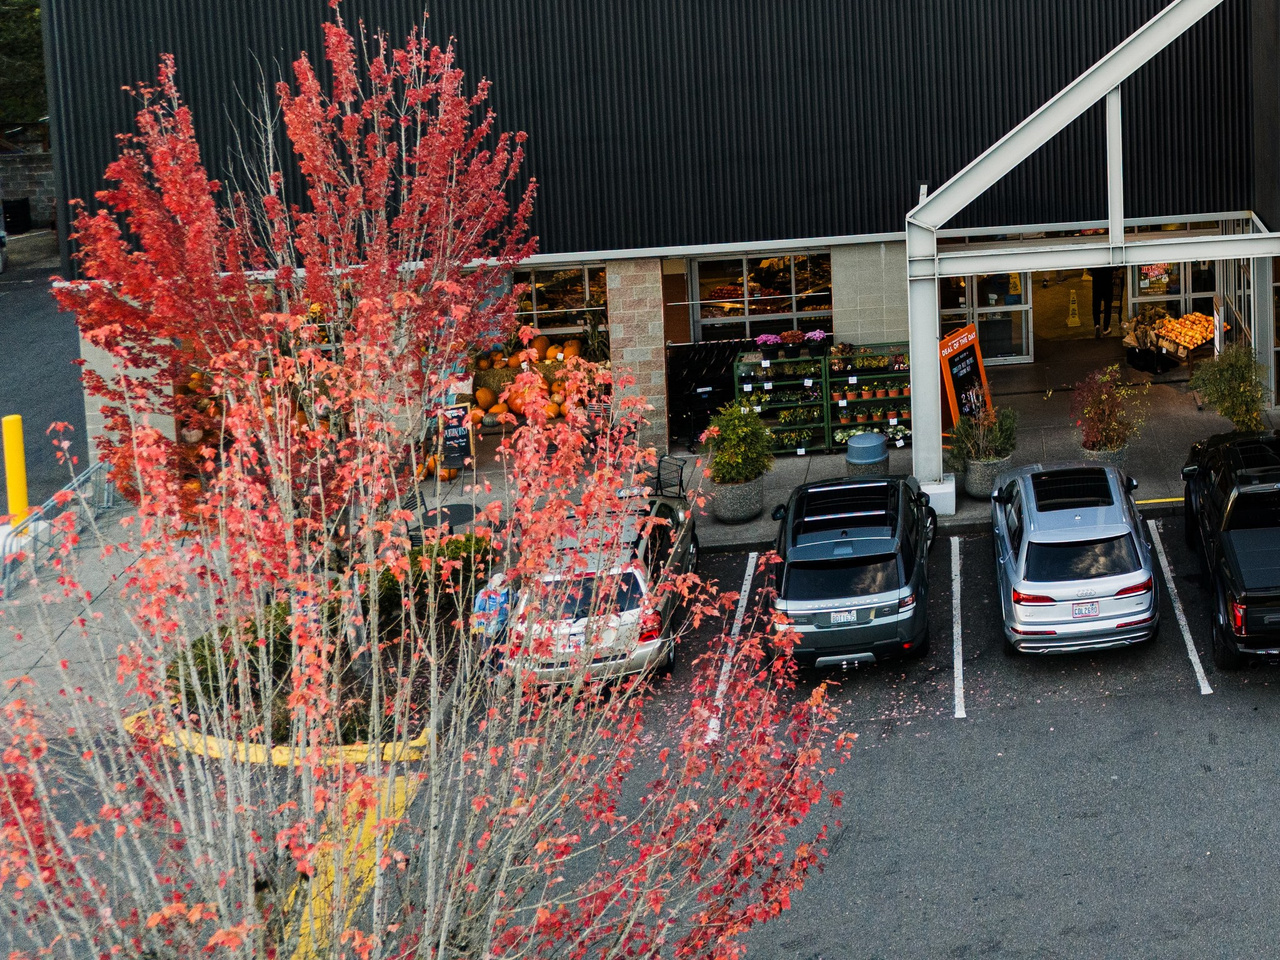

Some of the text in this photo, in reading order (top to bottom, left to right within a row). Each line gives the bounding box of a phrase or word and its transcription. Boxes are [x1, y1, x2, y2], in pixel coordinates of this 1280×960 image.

[942, 346, 953, 357] DEAL
[953, 342, 960, 350] OF
[960, 337, 968, 346] THE
[968, 332, 976, 341] DAY
